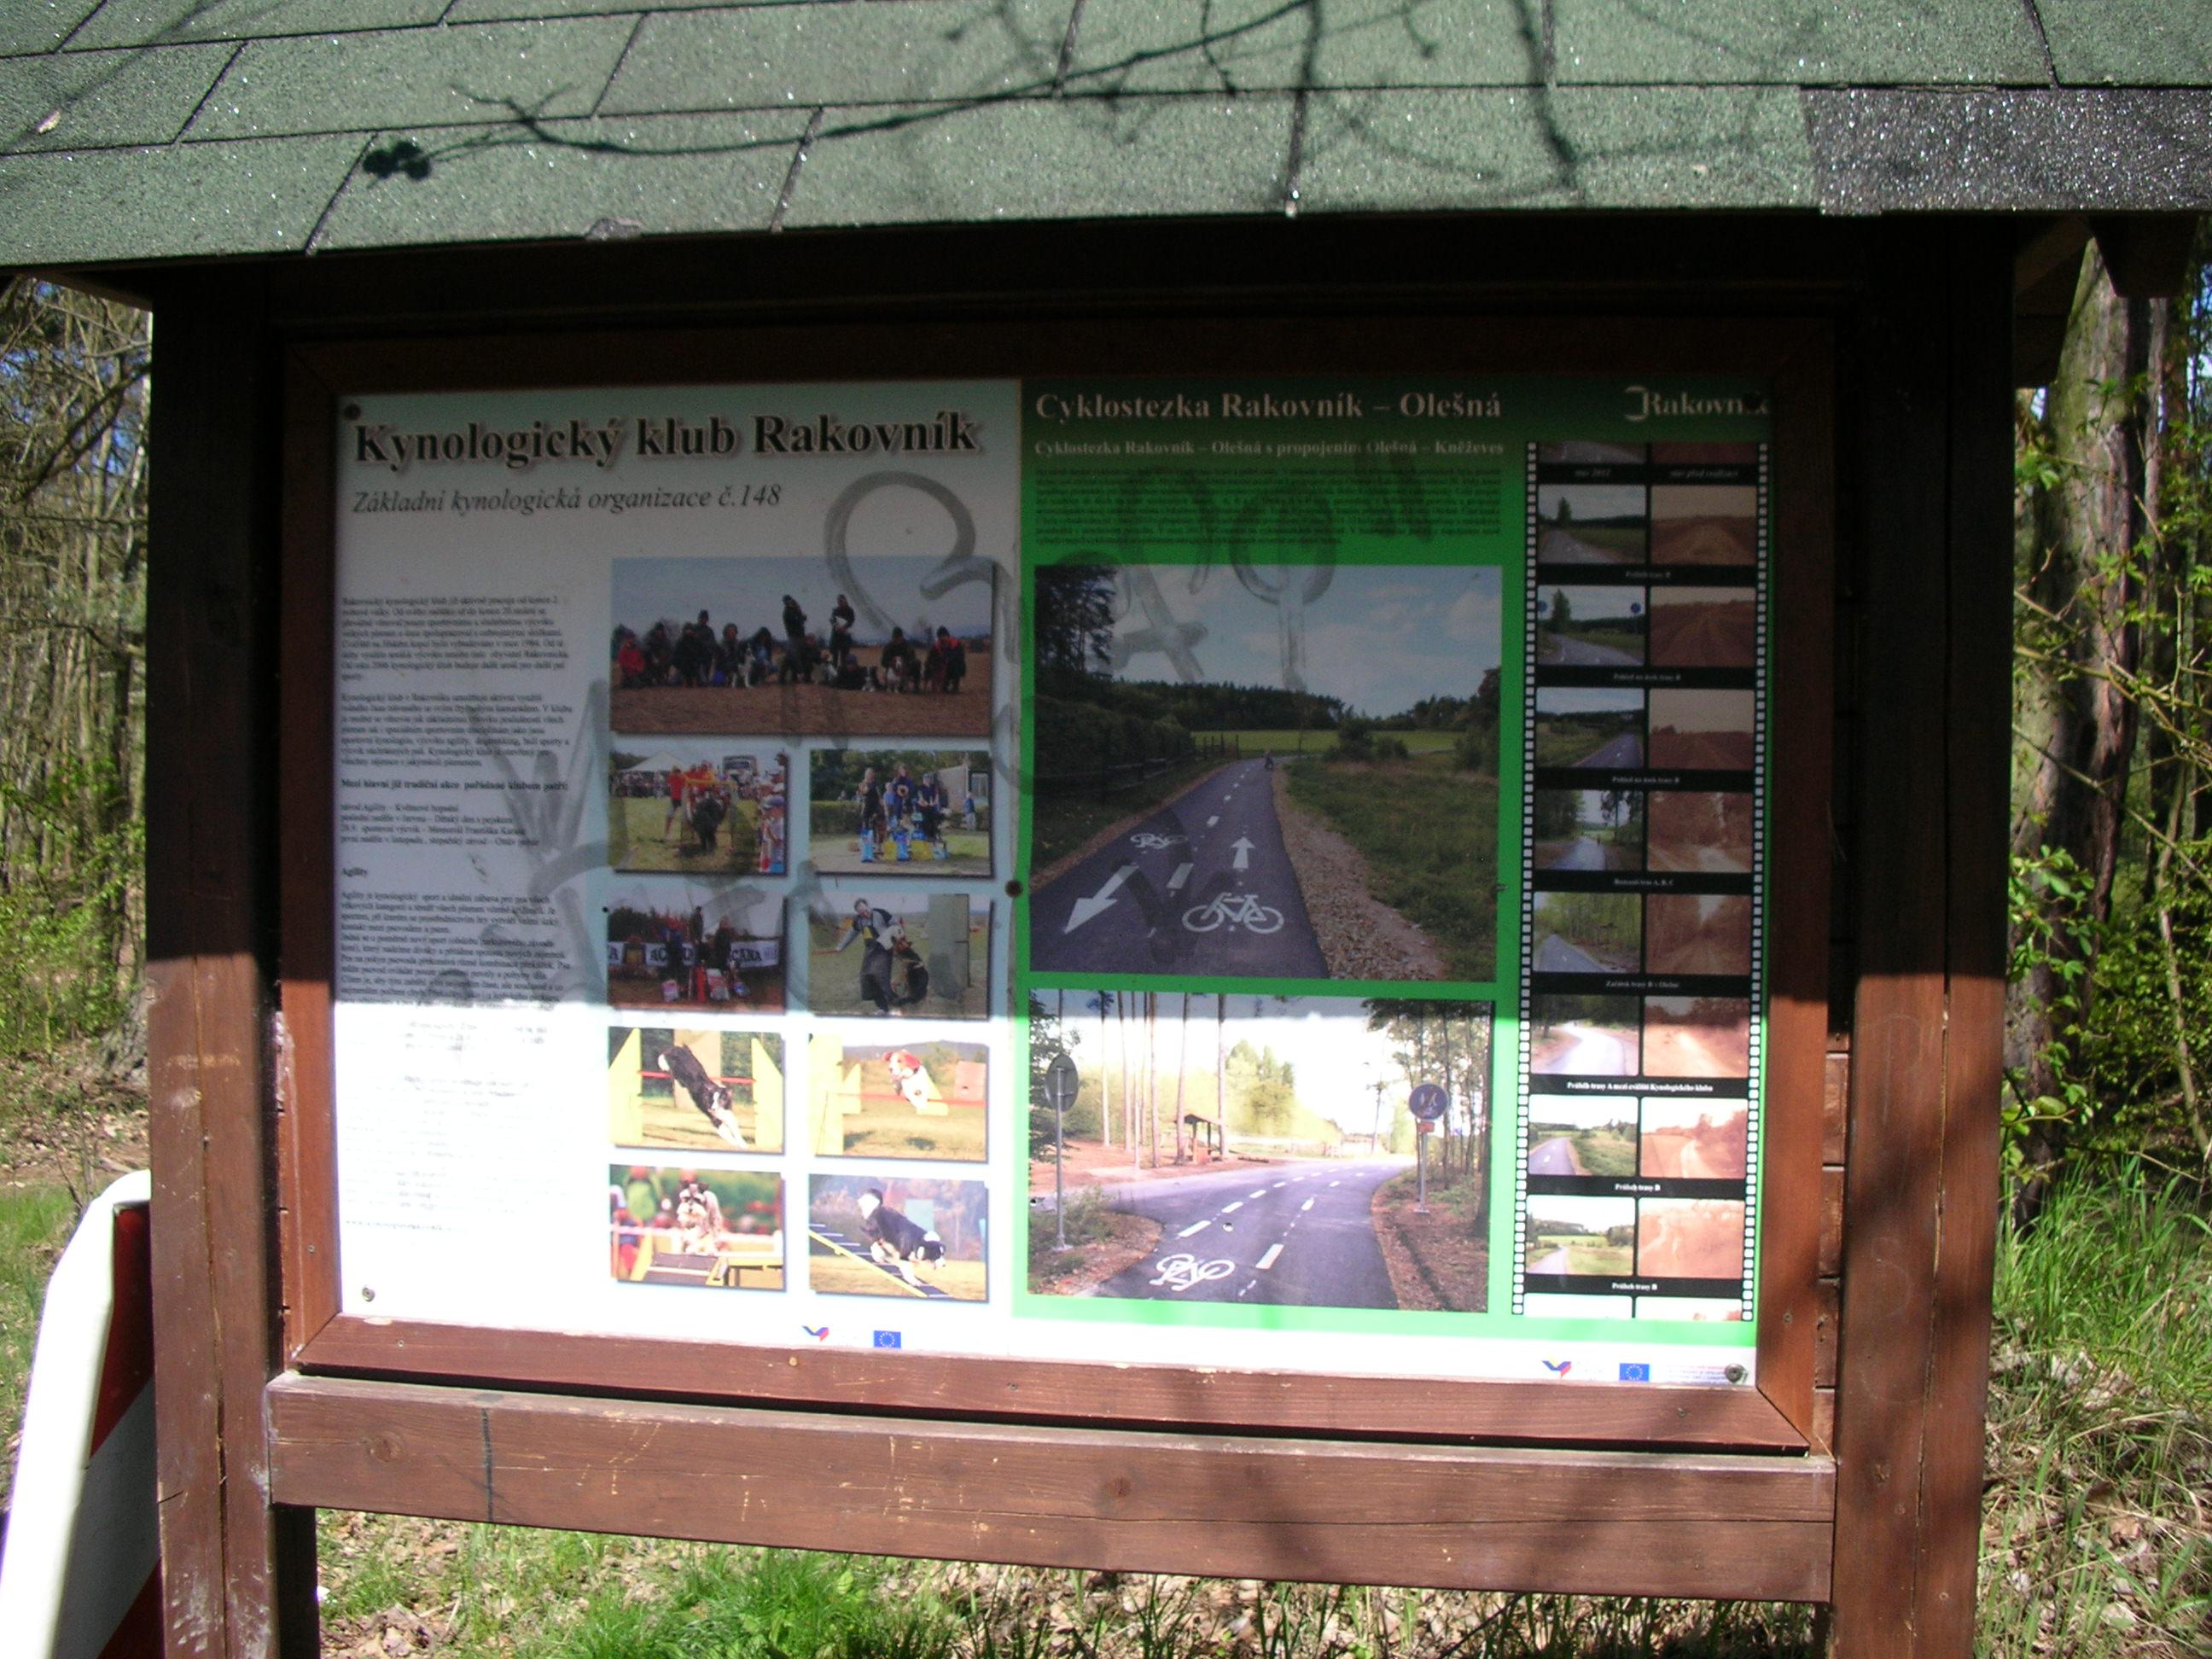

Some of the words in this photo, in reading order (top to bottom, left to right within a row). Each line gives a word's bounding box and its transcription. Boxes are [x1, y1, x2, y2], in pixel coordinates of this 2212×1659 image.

[1035, 393, 1210, 424] Cyklostezka
[1221, 392, 1364, 417] Rakovník
[1400, 392, 1502, 417] Olešná
[1624, 385, 1769, 422] Rakovn
[353, 417, 625, 472] Kynologický
[637, 416, 736, 456] klub
[753, 410, 980, 454] Rakovník
[1034, 440, 1121, 457] Cyklostezka
[1125, 440, 1195, 455] Rakovník
[1211, 439, 1262, 455] Olešná
[1277, 440, 1362, 457] propojením
[1435, 440, 1504, 455] Kněževes
[352, 490, 445, 513] Základní
[451, 487, 582, 515] kynologická
[588, 486, 711, 514] organizace
[719, 484, 782, 508] č.148
